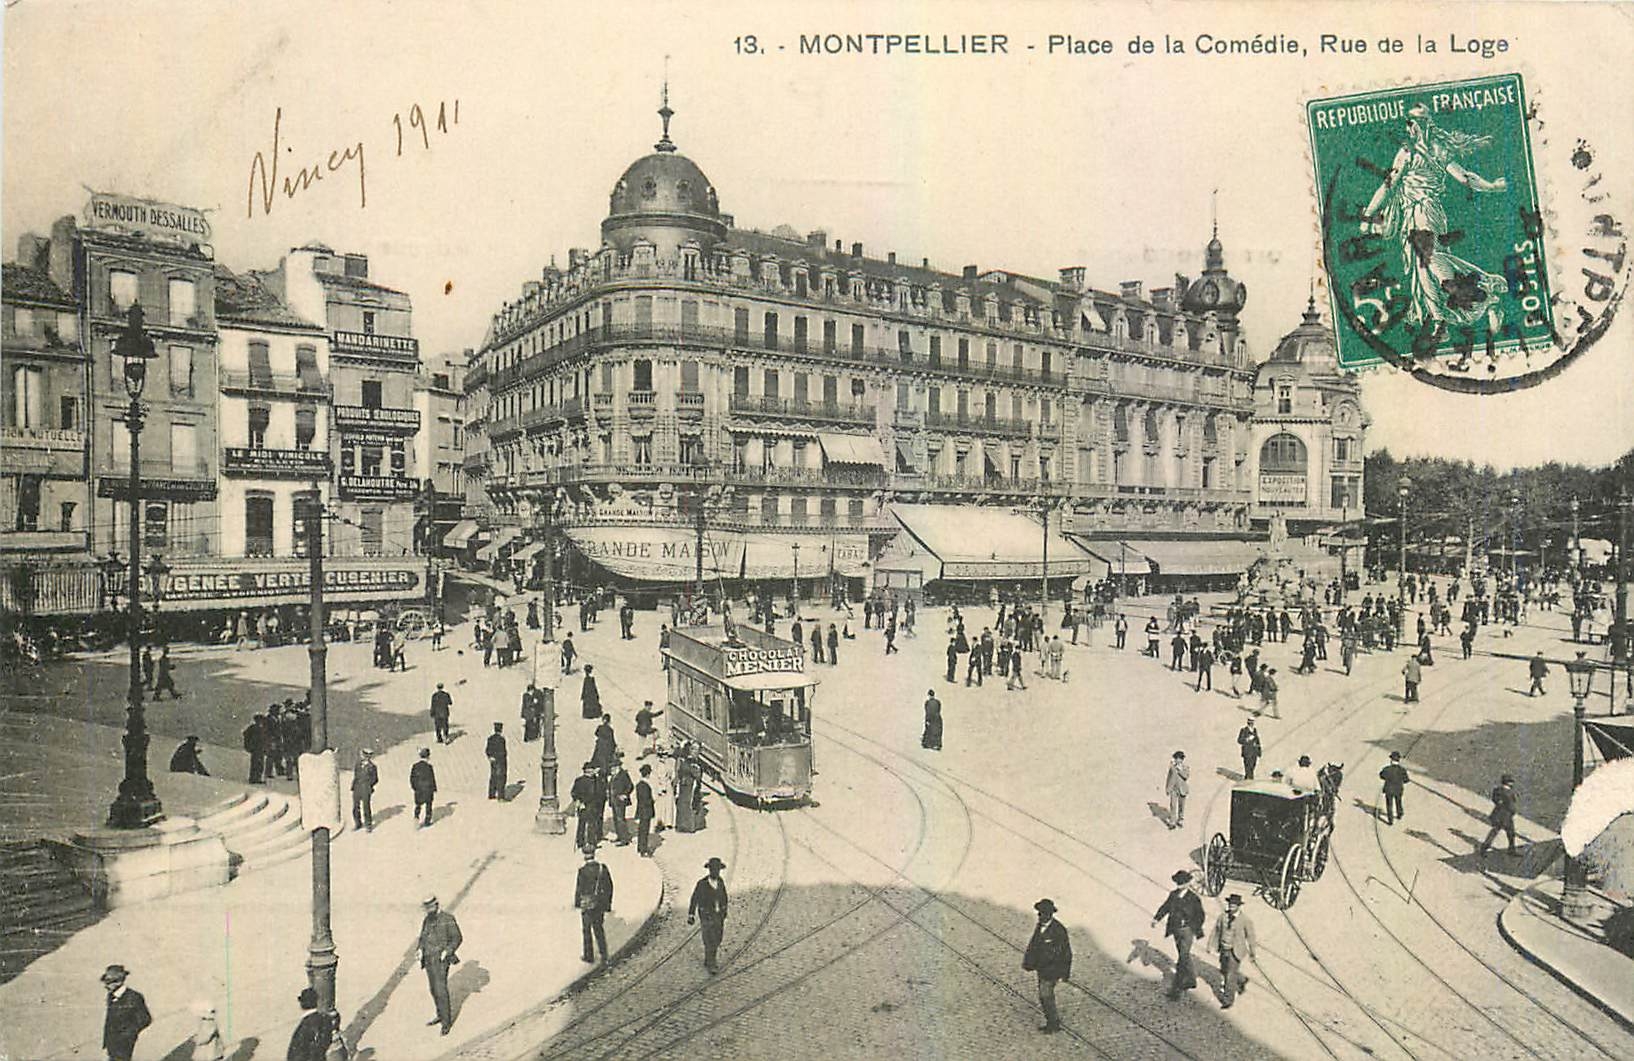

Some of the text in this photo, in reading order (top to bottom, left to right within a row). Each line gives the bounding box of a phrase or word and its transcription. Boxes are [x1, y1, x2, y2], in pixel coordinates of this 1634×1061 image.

[1432, 85, 1515, 112] FRANÇAISE
[92, 201, 205, 234] VERMOUTH DESSALLES
[337, 332, 416, 350] MANDARINETTE
[231, 450, 324, 461] LE MIDI VINICOLE
[254, 573, 312, 589] VERTE
[325, 571, 409, 585] CUSENIER
[729, 647, 799, 661] CHOCOLAT
[726, 657, 803, 676] MENIER
